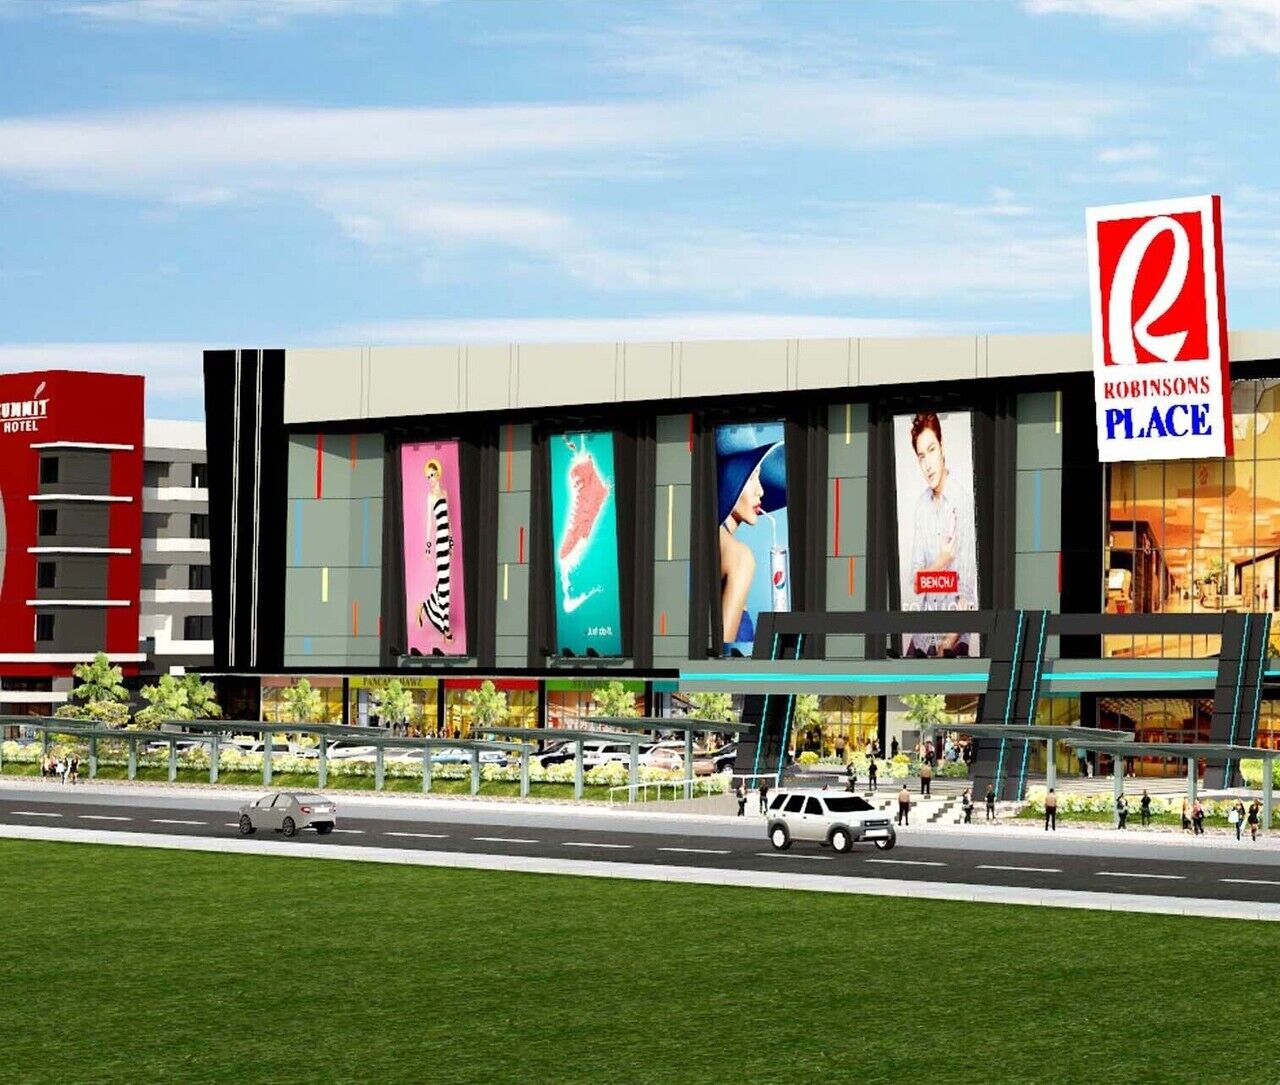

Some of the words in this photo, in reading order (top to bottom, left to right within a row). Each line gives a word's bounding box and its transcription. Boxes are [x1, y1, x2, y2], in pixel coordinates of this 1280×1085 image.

[1103, 376, 1210, 400] ROBINSONS
[0, 399, 50, 418] UMMIT
[3, 420, 39, 433] HOTEL
[1105, 403, 1212, 440] PLACE
